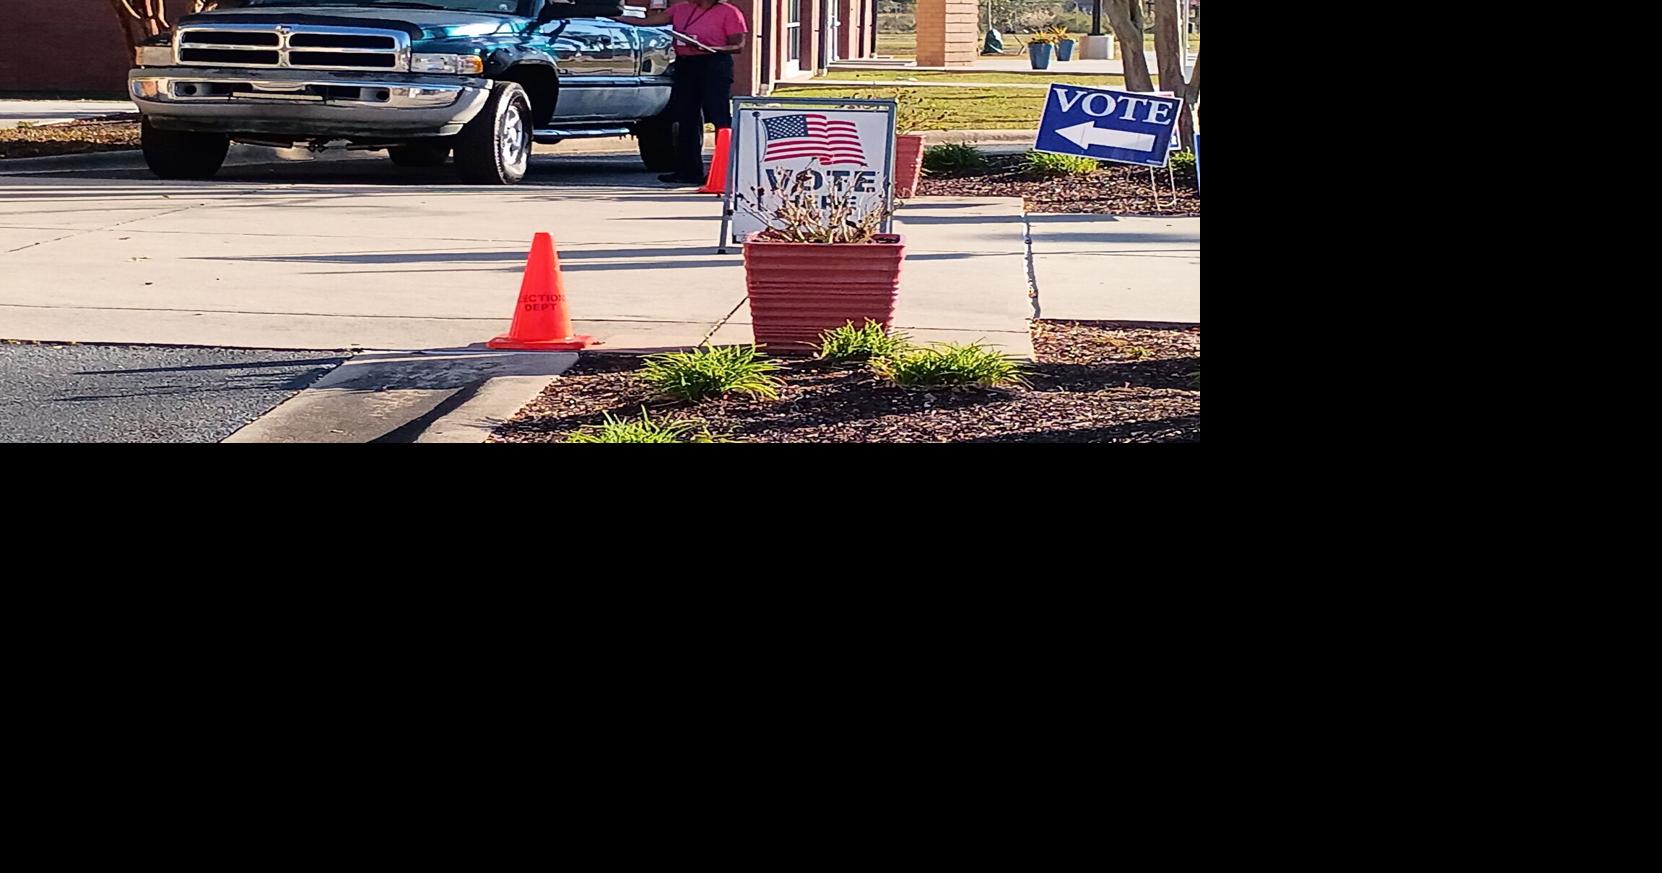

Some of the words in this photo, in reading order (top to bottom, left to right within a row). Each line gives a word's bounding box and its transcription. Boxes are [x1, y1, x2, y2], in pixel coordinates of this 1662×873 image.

[1053, 88, 1173, 125] VOTE
[765, 169, 876, 193] VOTE
[525, 303, 557, 311] DEPT
